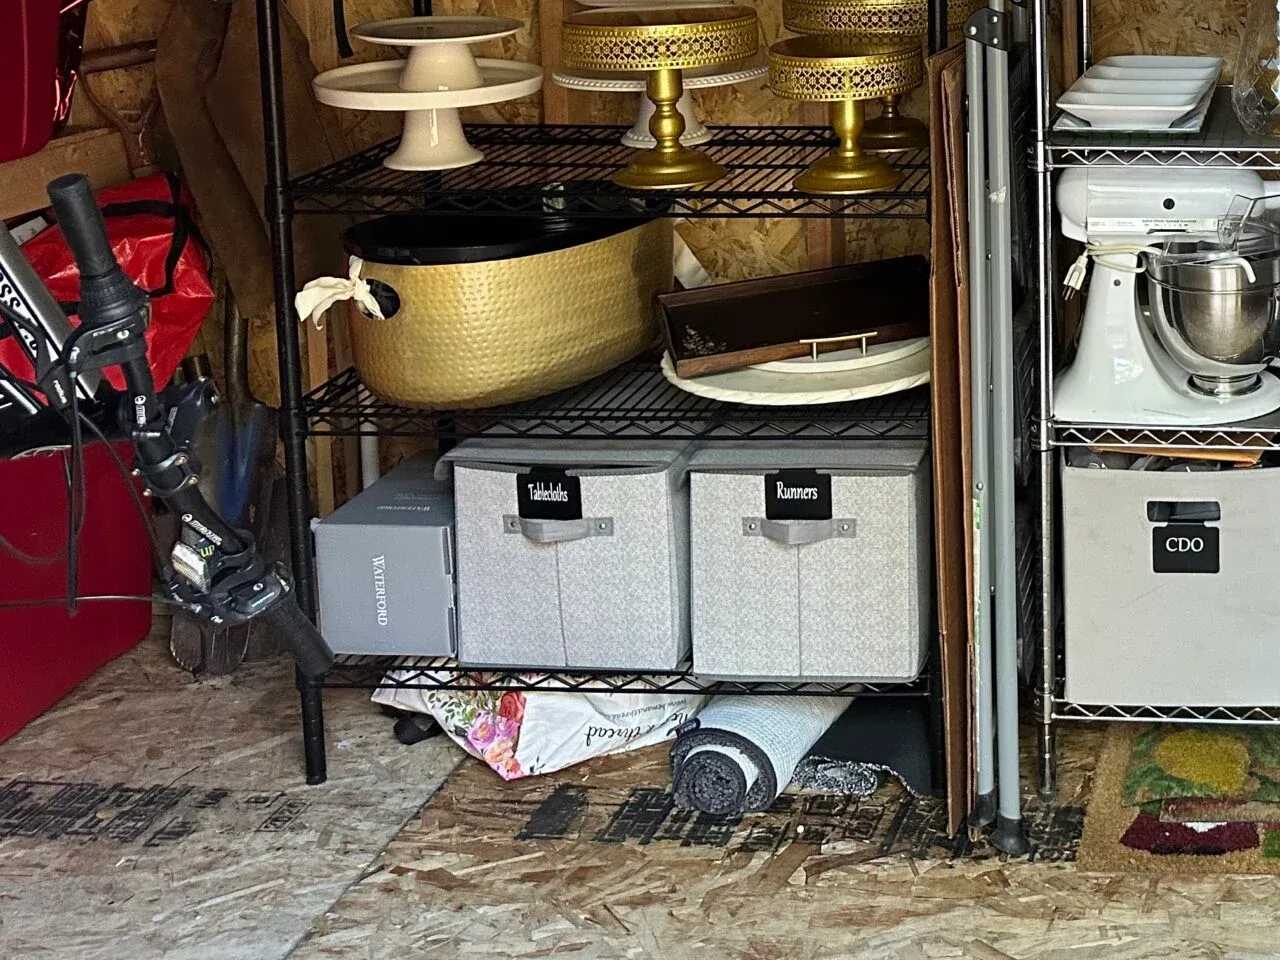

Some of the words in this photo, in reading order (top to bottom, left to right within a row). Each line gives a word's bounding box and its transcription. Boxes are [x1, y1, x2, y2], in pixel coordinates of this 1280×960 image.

[528, 481, 568, 502] Tablecloths
[776, 481, 818, 499] Runners
[1166, 537, 1204, 552] CDO
[372, 554, 388, 626] WATERFORD
[584, 725, 641, 746] thread
